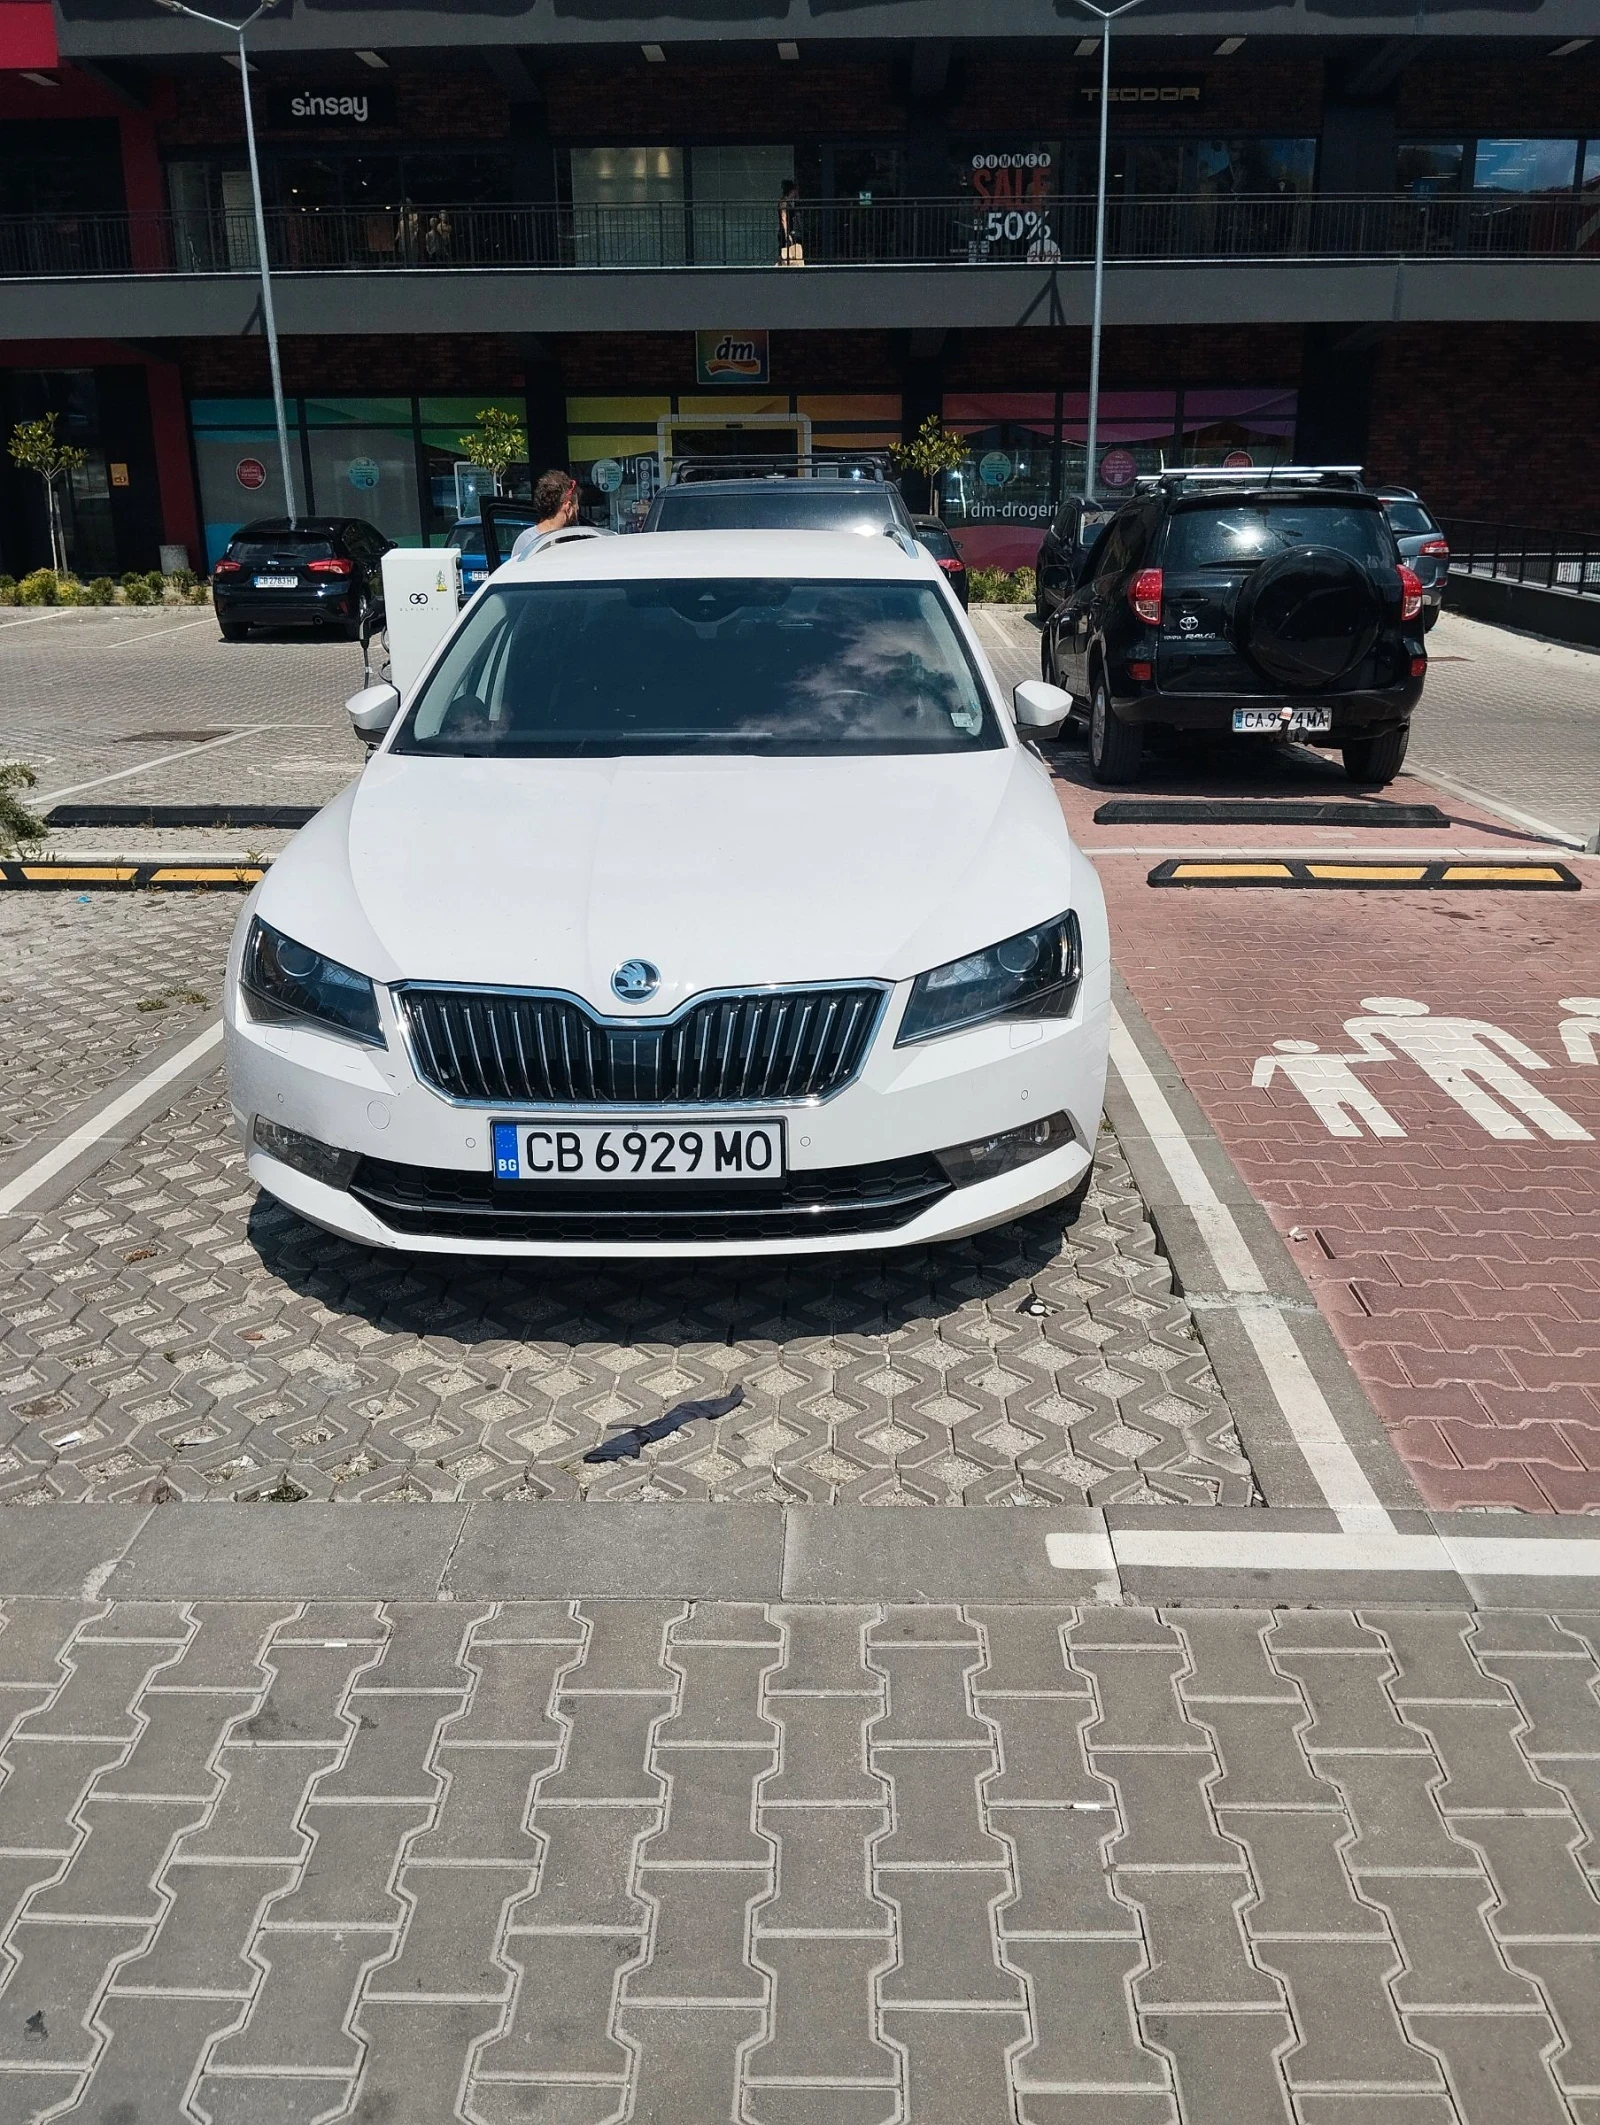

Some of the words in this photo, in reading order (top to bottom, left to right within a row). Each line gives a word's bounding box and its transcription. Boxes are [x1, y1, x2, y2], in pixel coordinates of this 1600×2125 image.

[291, 91, 368, 122] sinsay
[1081, 87, 1200, 101] TEODOR
[972, 153, 1051, 169] SUMMER
[972, 168, 1050, 211] SALE
[715, 335, 755, 361] dm
[1245, 713, 1264, 728] CA
[1307, 712, 1326, 728] MA
[498, 1158, 518, 1171] BG
[526, 1131, 584, 1172] CB
[595, 1131, 703, 1173] 6929
[714, 1130, 773, 1172] MO
